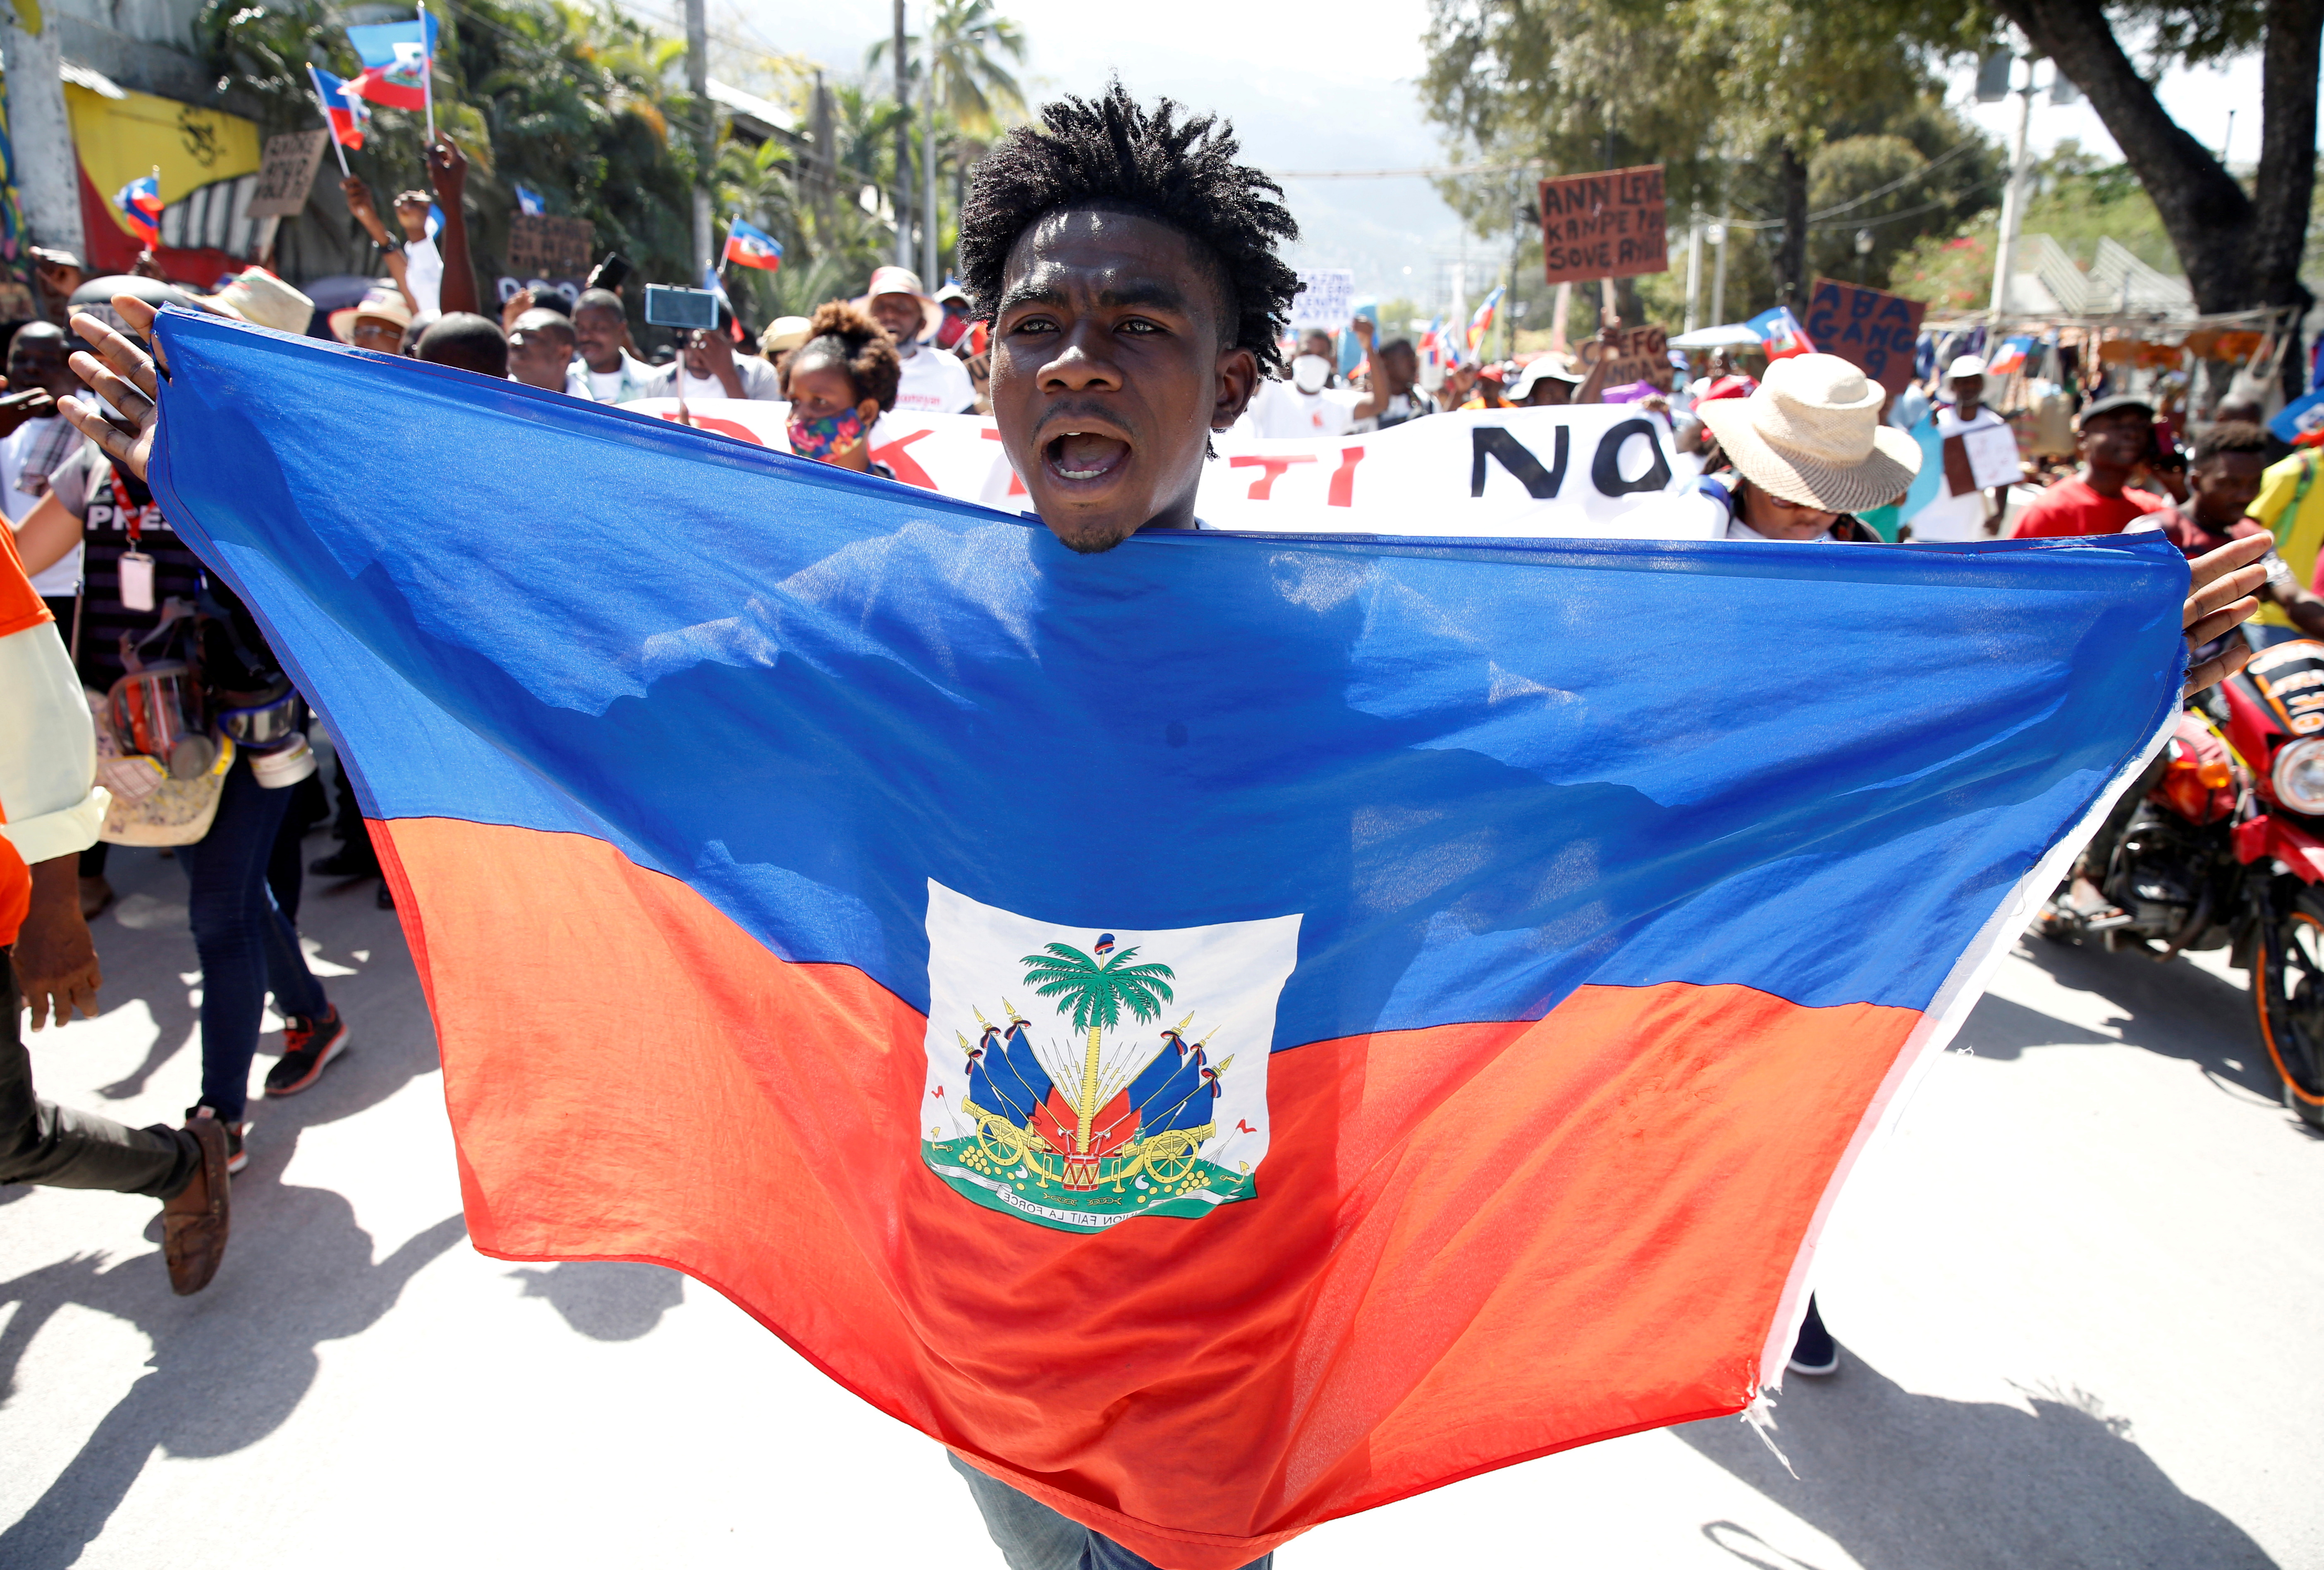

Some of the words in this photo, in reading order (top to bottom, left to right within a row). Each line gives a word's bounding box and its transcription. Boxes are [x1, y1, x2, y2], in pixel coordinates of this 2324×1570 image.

[1546, 177, 1611, 215] ANN
[1547, 211, 1628, 245] KANPE
[1549, 242, 1611, 270] SOVE
[1813, 284, 1911, 322] ABA
[1809, 311, 1916, 352] GANG
[1471, 419, 1672, 499] NO
